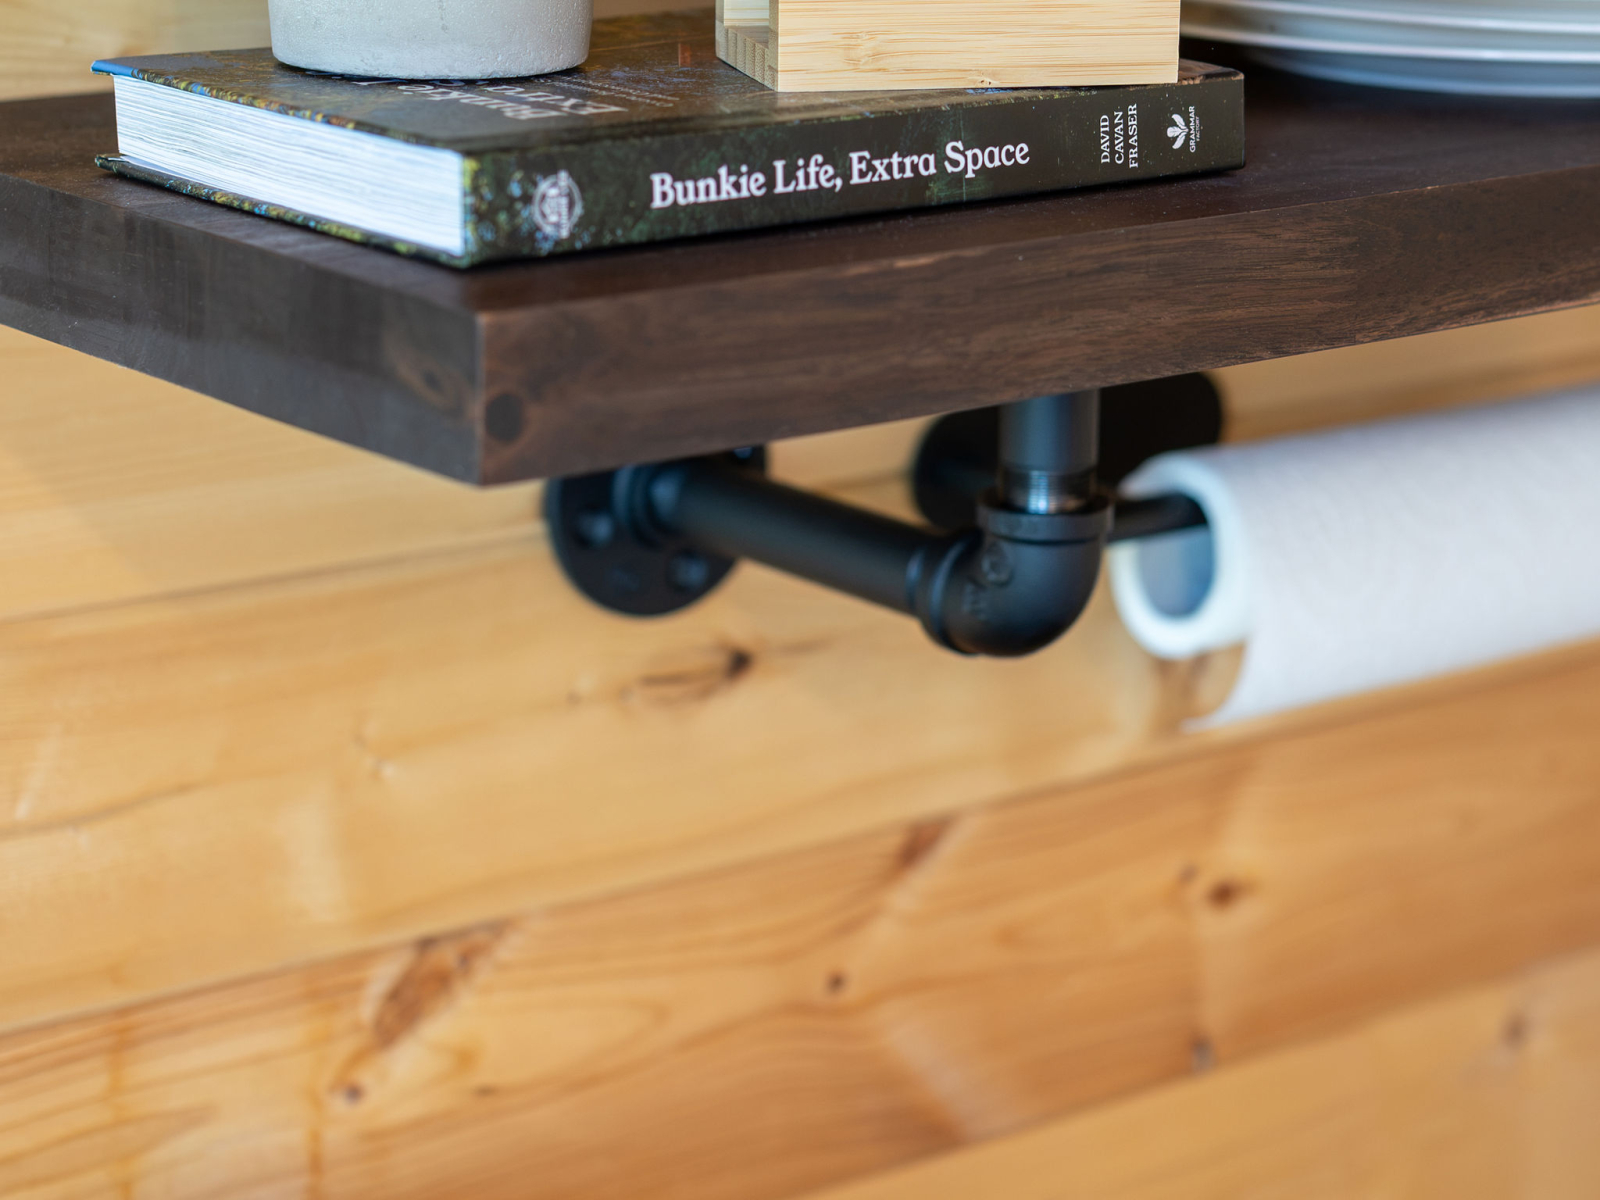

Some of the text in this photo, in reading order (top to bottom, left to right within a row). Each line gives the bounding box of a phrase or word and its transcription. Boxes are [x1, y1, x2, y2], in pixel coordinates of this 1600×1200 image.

[1100, 114, 1110, 164] DAVID
[1114, 111, 1124, 165] CAVAN
[1127, 103, 1138, 169] FRASER
[1188, 105, 1196, 153] GRAMMAR
[649, 140, 1031, 209] Bunkie Life, Extra Space
